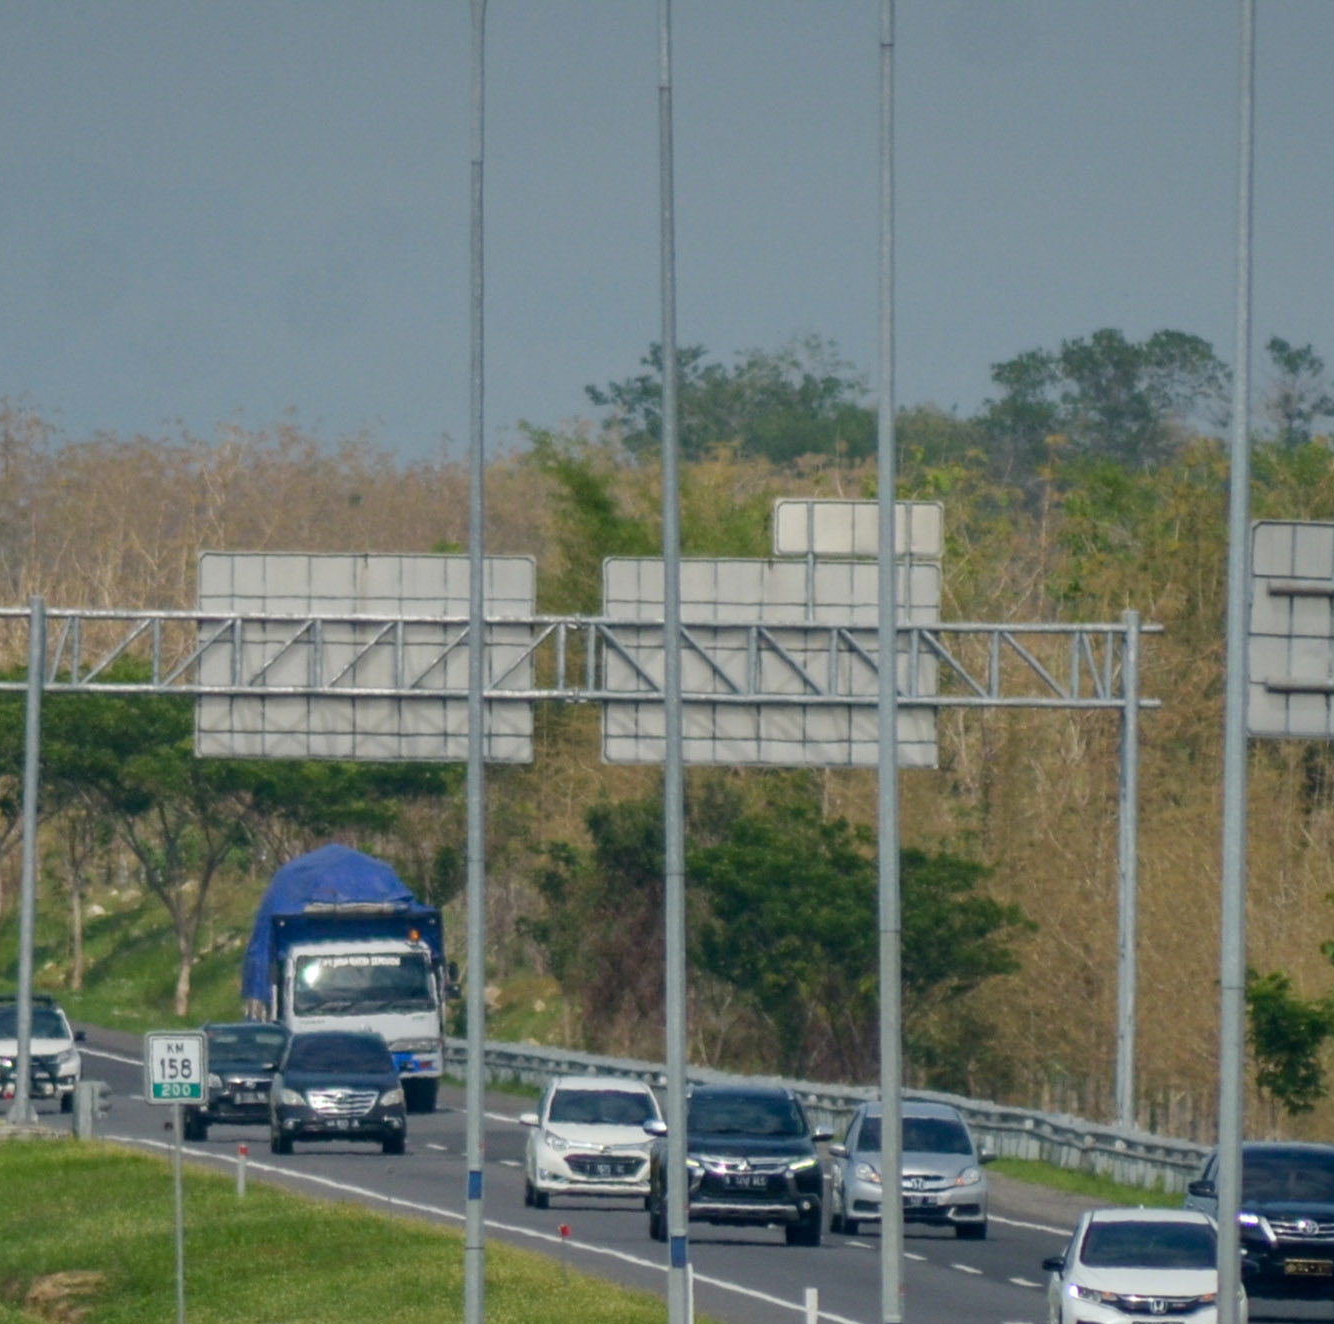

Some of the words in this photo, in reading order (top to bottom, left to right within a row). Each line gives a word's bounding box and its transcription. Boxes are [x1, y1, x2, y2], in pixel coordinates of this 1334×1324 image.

[167, 1042, 185, 1054] KM
[160, 1058, 193, 1080] 158
[161, 1083, 192, 1097] 200
